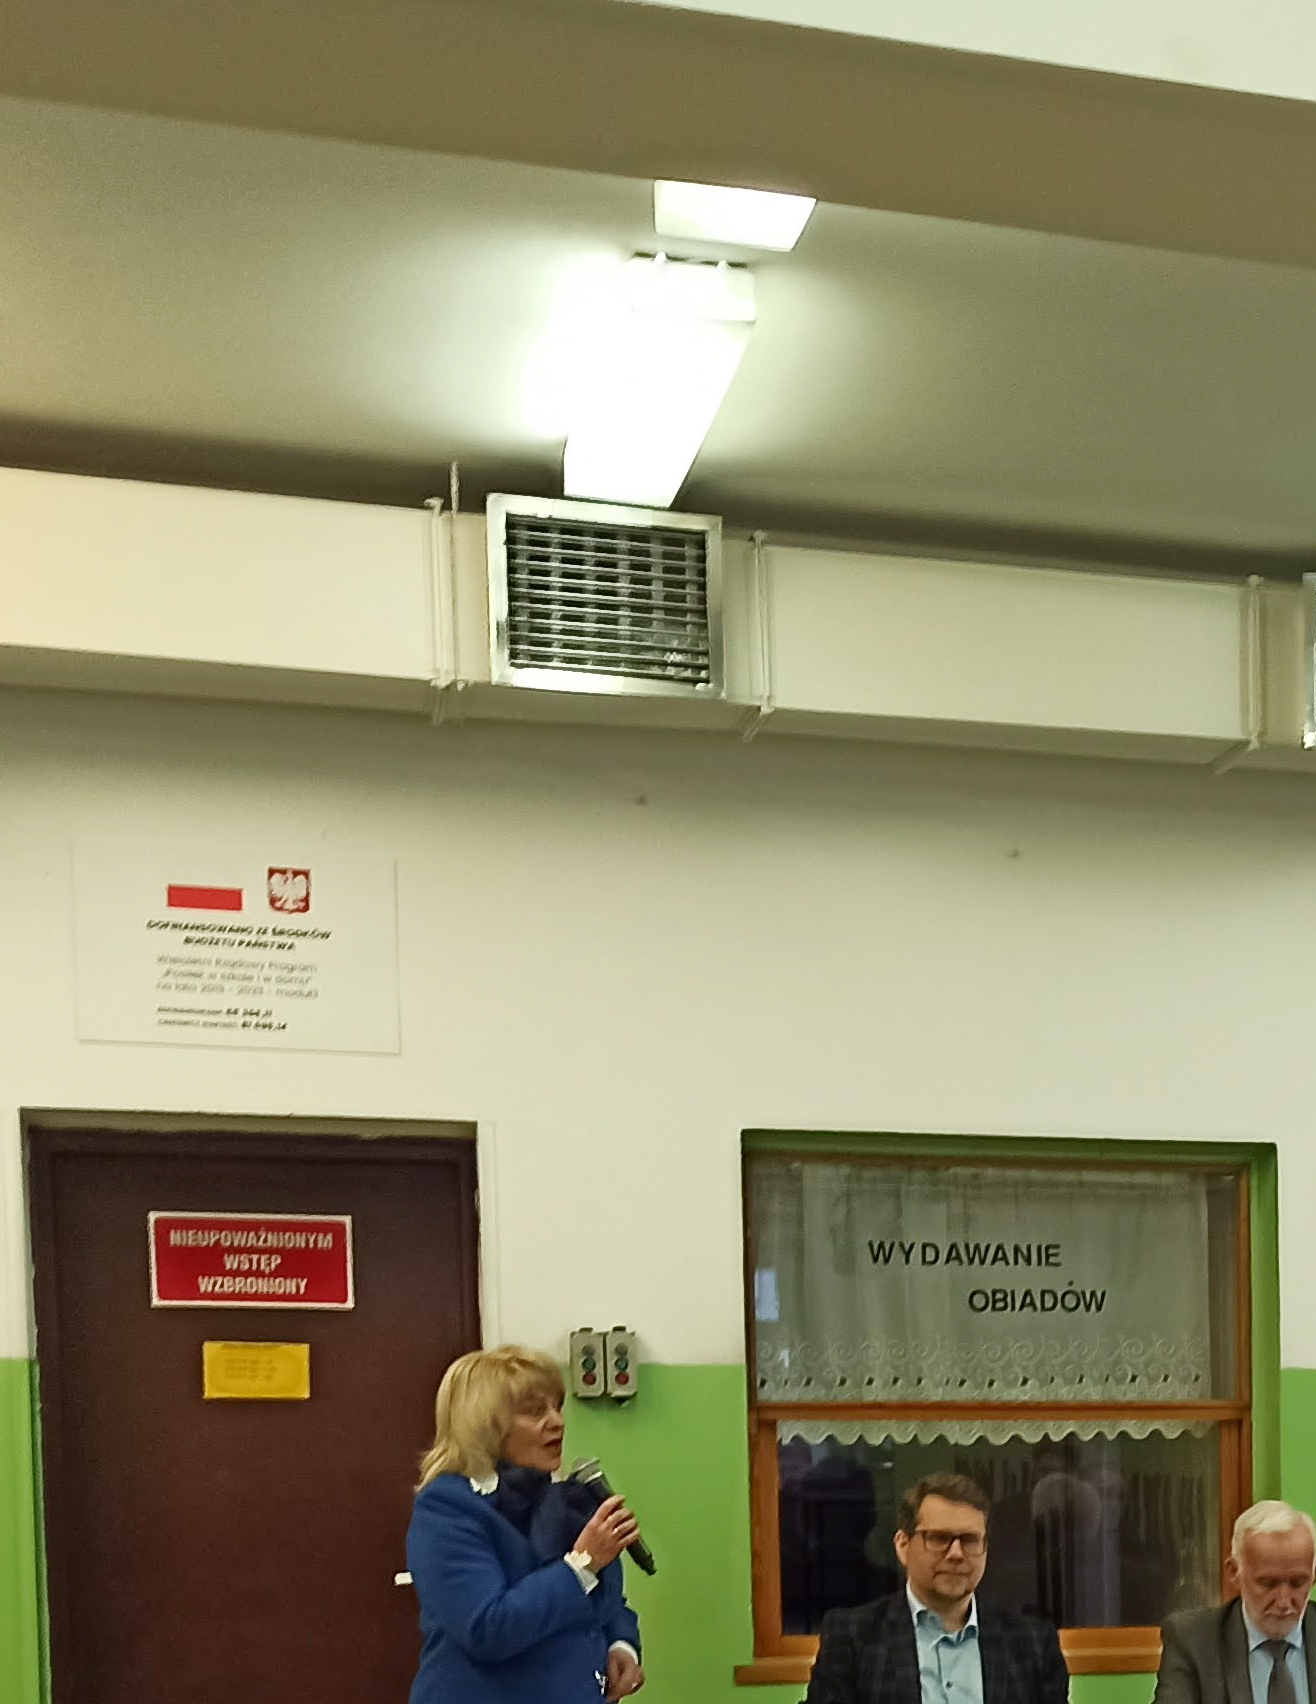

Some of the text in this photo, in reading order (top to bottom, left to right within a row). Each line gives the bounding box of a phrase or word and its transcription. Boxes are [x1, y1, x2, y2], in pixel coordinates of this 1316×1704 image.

[268, 959, 318, 974] Program
[170, 1227, 333, 1250] NIEUPOWAŻNIONYM
[223, 1253, 282, 1274] WSTĘP
[868, 1240, 1062, 1268] WYDAWANIE
[198, 1275, 308, 1295] WZBRONIONY
[968, 1280, 1106, 1313] OBIADÓW
